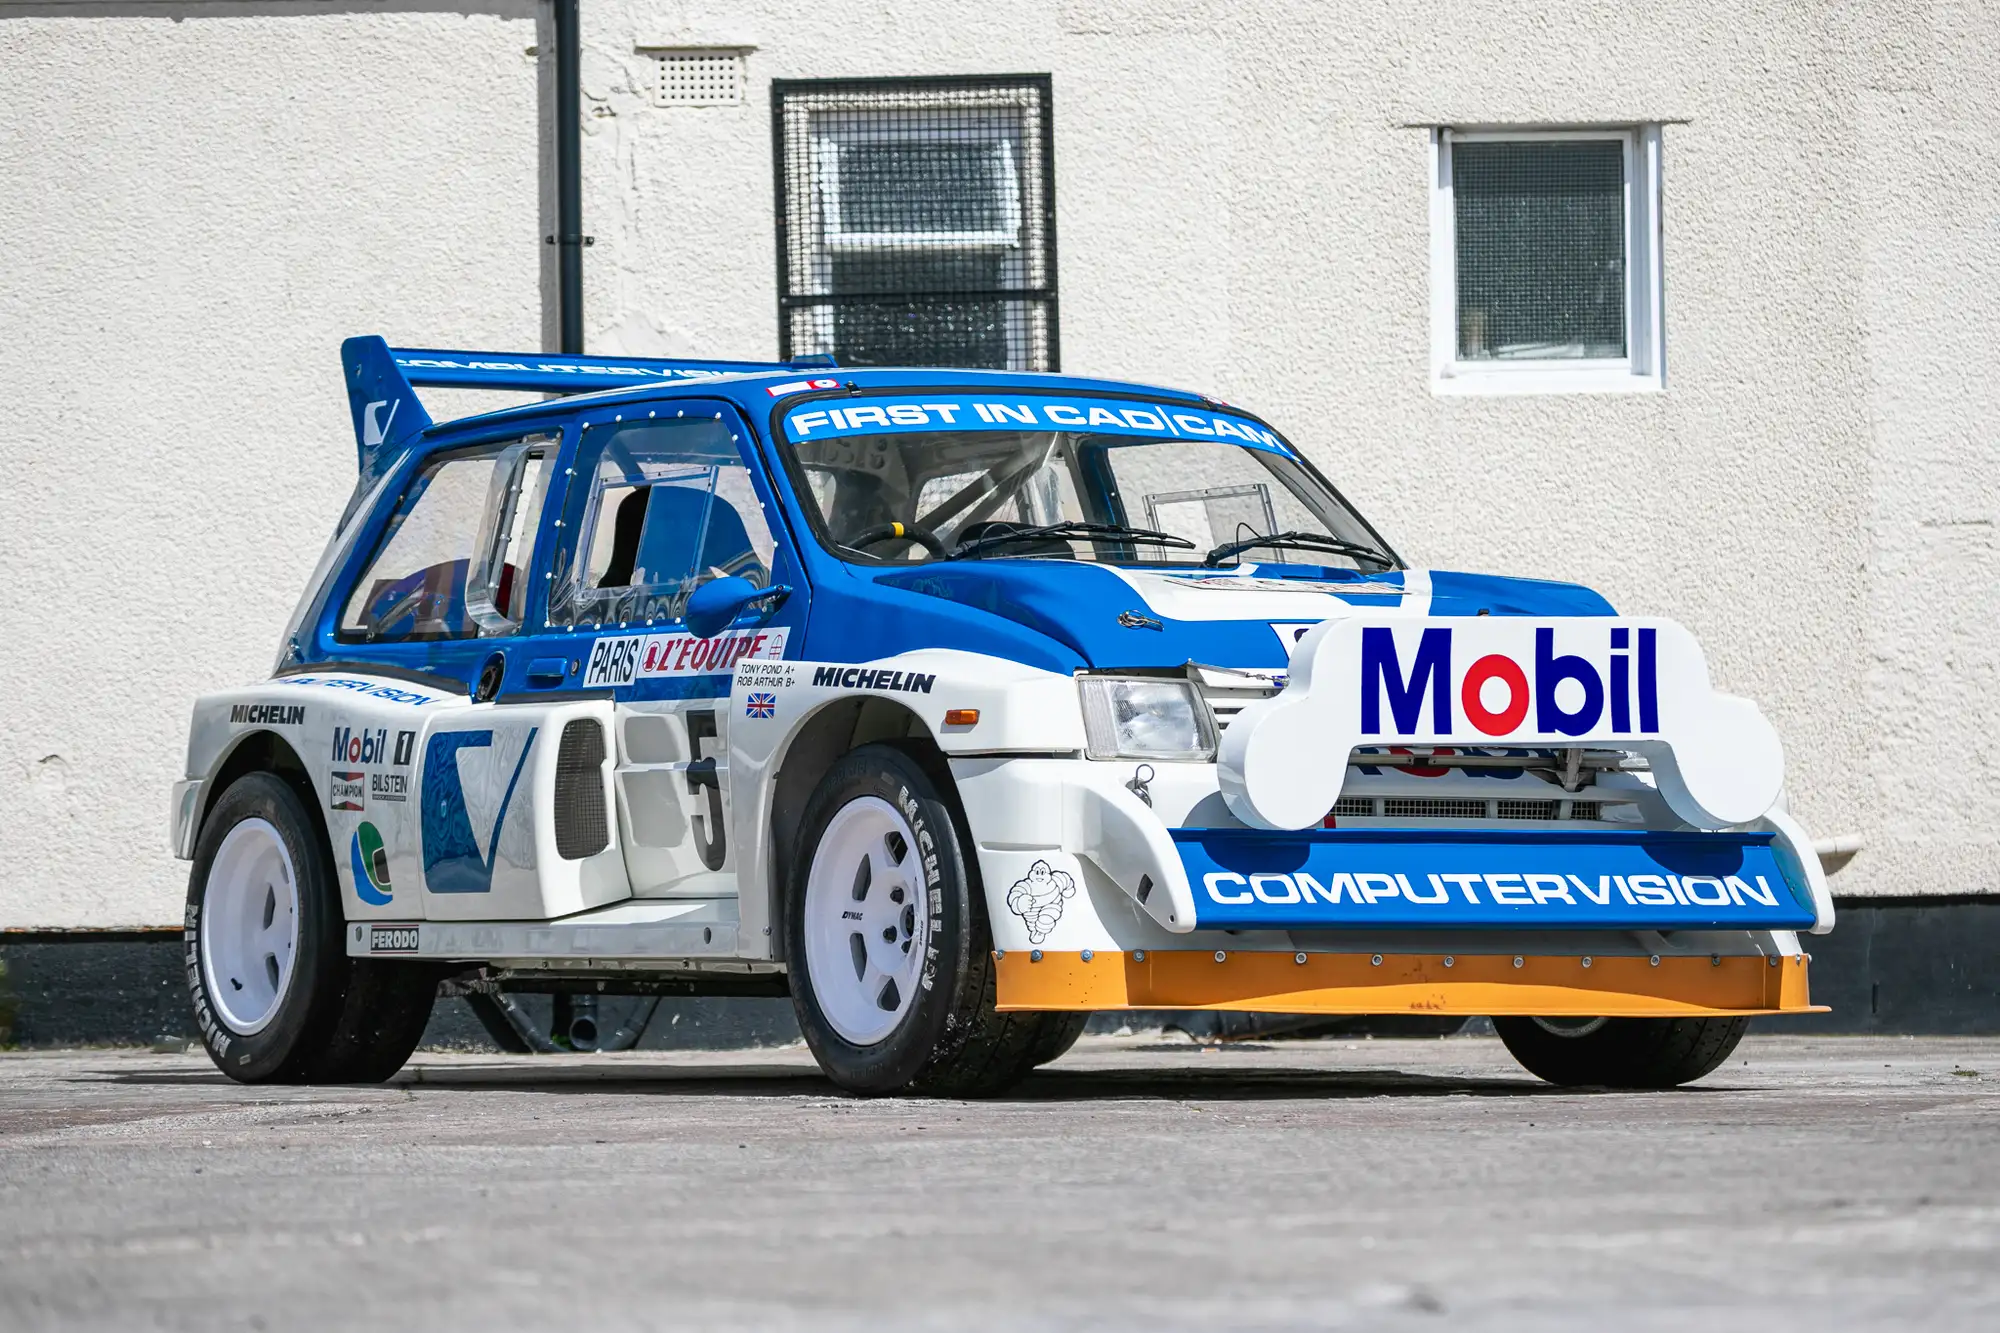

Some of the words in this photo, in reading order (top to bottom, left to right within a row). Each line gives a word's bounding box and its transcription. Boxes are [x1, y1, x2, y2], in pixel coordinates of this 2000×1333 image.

[791, 405, 946, 435] FIRST
[973, 404, 1036, 423] IN
[588, 639, 638, 683] PARIS
[741, 664, 759, 674] TONY
[761, 664, 782, 674] POND
[785, 664, 795, 674] A+
[737, 677, 752, 686] ROB
[753, 677, 783, 688] ARTHUR
[786, 679, 796, 688] B+
[812, 667, 936, 694] MICHELIN
[1361, 627, 1659, 736] Mobil
[231, 705, 305, 725] MICHELIN
[332, 727, 387, 764] Mobil
[398, 731, 412, 764] 1
[332, 784, 363, 798] CHAMPION
[372, 774, 408, 793] BILSTEIN
[686, 709, 728, 873] 5
[1203, 872, 1779, 907] COMPUTERVISION
[842, 911, 863, 921] DYMAC
[371, 931, 418, 948] FERODO
[184, 904, 231, 1058] MICHELIN
